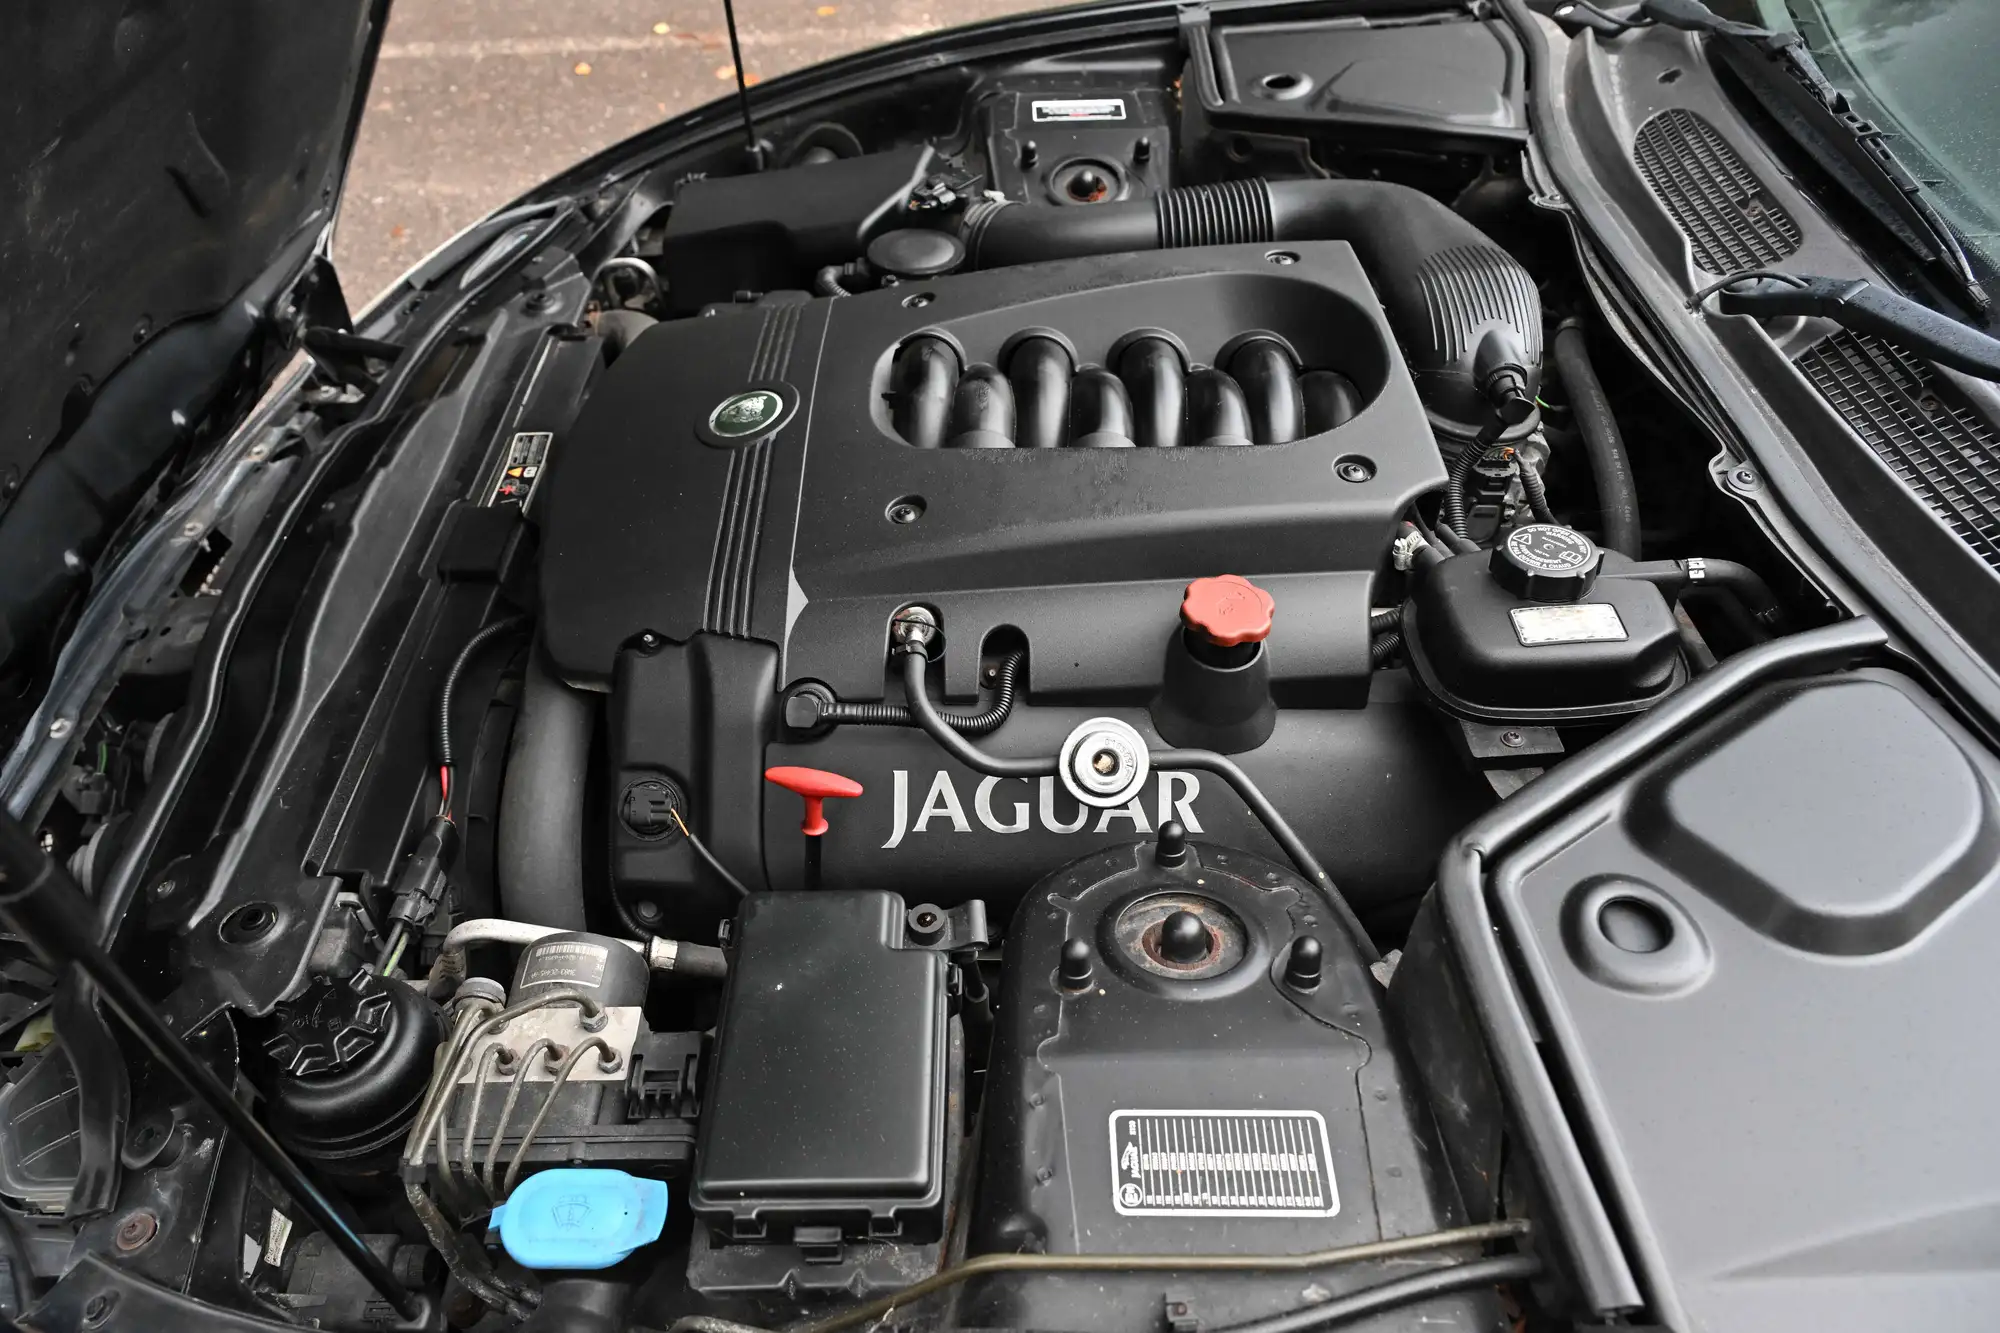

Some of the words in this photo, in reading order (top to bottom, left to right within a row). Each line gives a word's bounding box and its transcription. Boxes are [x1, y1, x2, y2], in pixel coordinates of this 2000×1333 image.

[1545, 531, 1574, 545] WARNING
[1552, 527, 1571, 537] OPEN
[1519, 544, 1562, 564] AVERTISSEMENT
[880, 770, 1204, 849] JAGUAR
